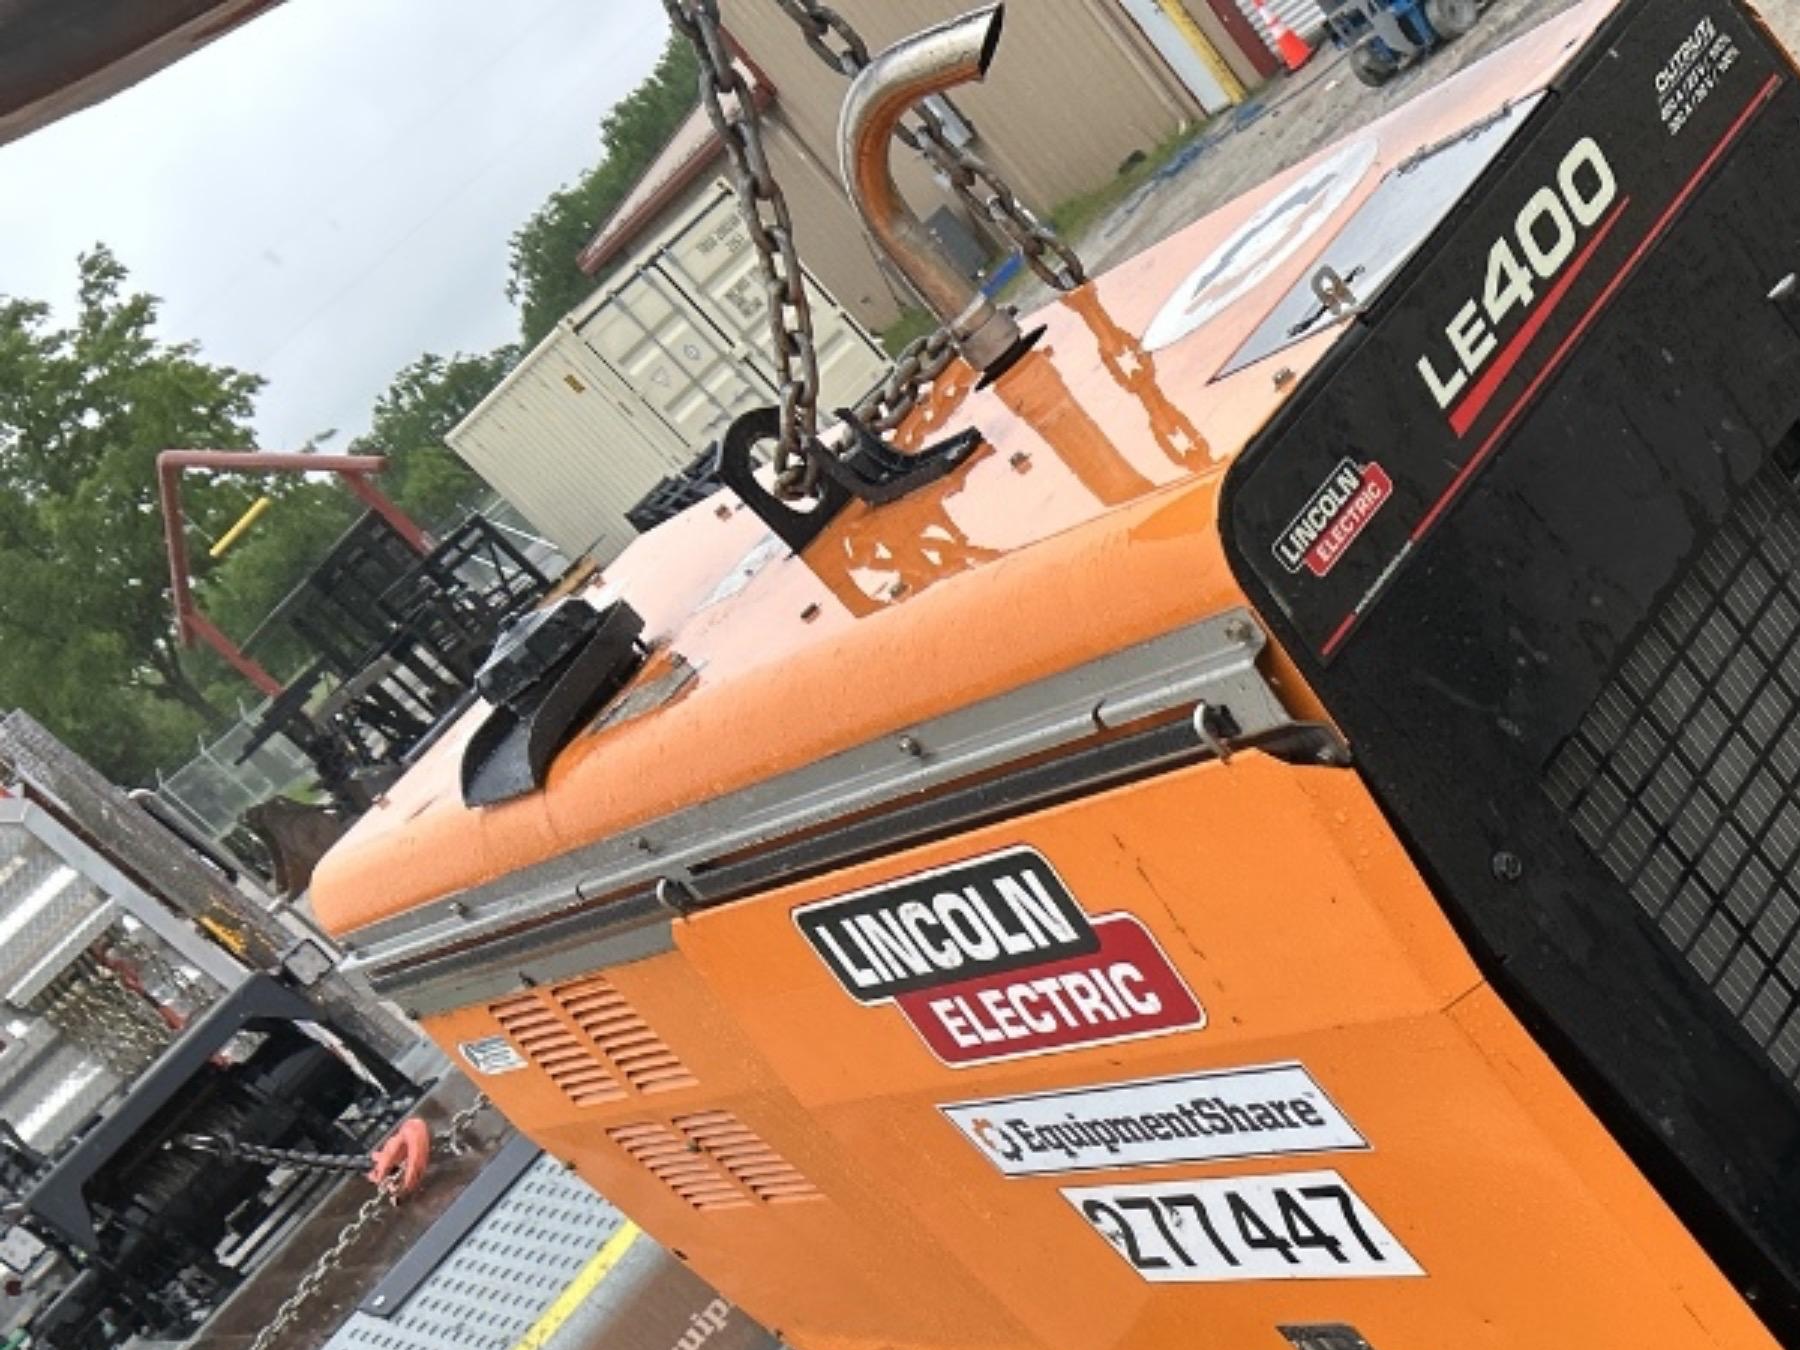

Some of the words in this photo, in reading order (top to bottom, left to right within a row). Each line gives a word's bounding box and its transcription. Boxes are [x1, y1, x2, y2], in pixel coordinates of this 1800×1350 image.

[1416, 137, 1617, 409] LE400
[1279, 467, 1361, 564] LINCOLN
[1315, 480, 1381, 563] ELECTRIC
[814, 867, 1078, 988] LINCOLN
[929, 961, 1162, 1050] ELECTRIC
[1005, 1096, 1326, 1160] EquipmentShare
[1082, 1184, 1387, 1269] 277447
